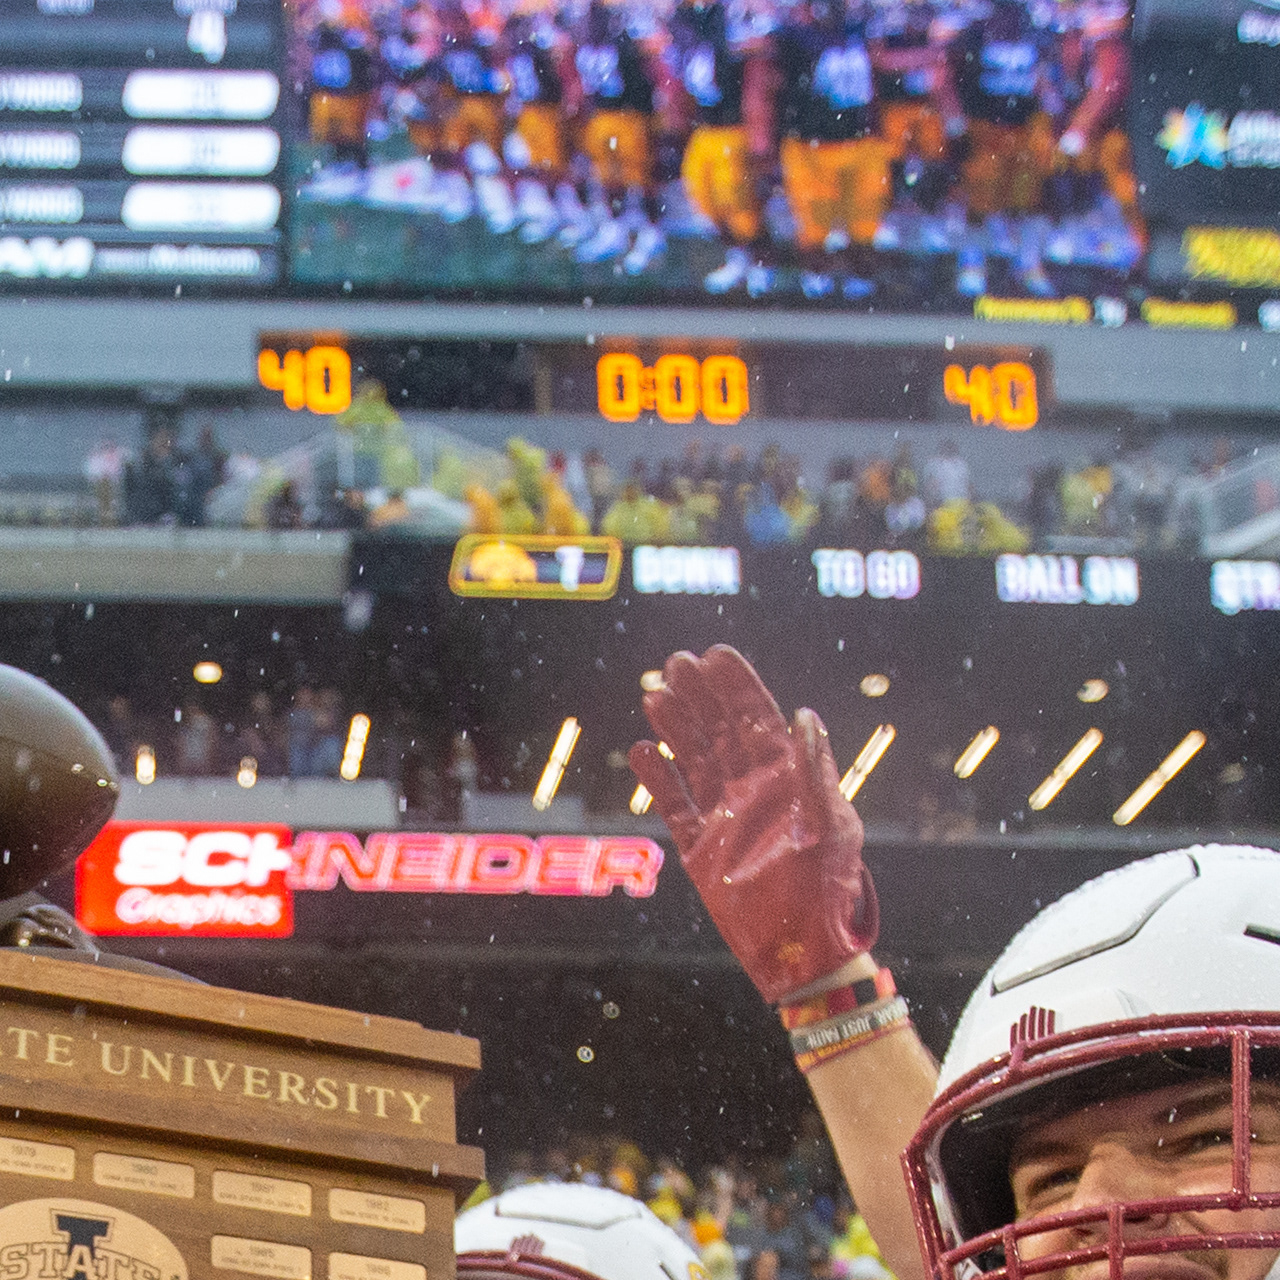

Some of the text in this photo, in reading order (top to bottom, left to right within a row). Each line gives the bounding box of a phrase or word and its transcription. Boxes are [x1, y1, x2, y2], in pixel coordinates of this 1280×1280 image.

[258, 346, 351, 414] 40
[596, 352, 749, 424] 0:00
[943, 362, 1038, 431] 40
[632, 545, 741, 595] DOWN
[812, 548, 866, 597] TO
[996, 554, 1140, 605] BALL ON
[114, 830, 665, 898] SCHNEIDER
[116, 887, 282, 930] Graphics
[100, 1041, 432, 1125] UNIVERSITY
